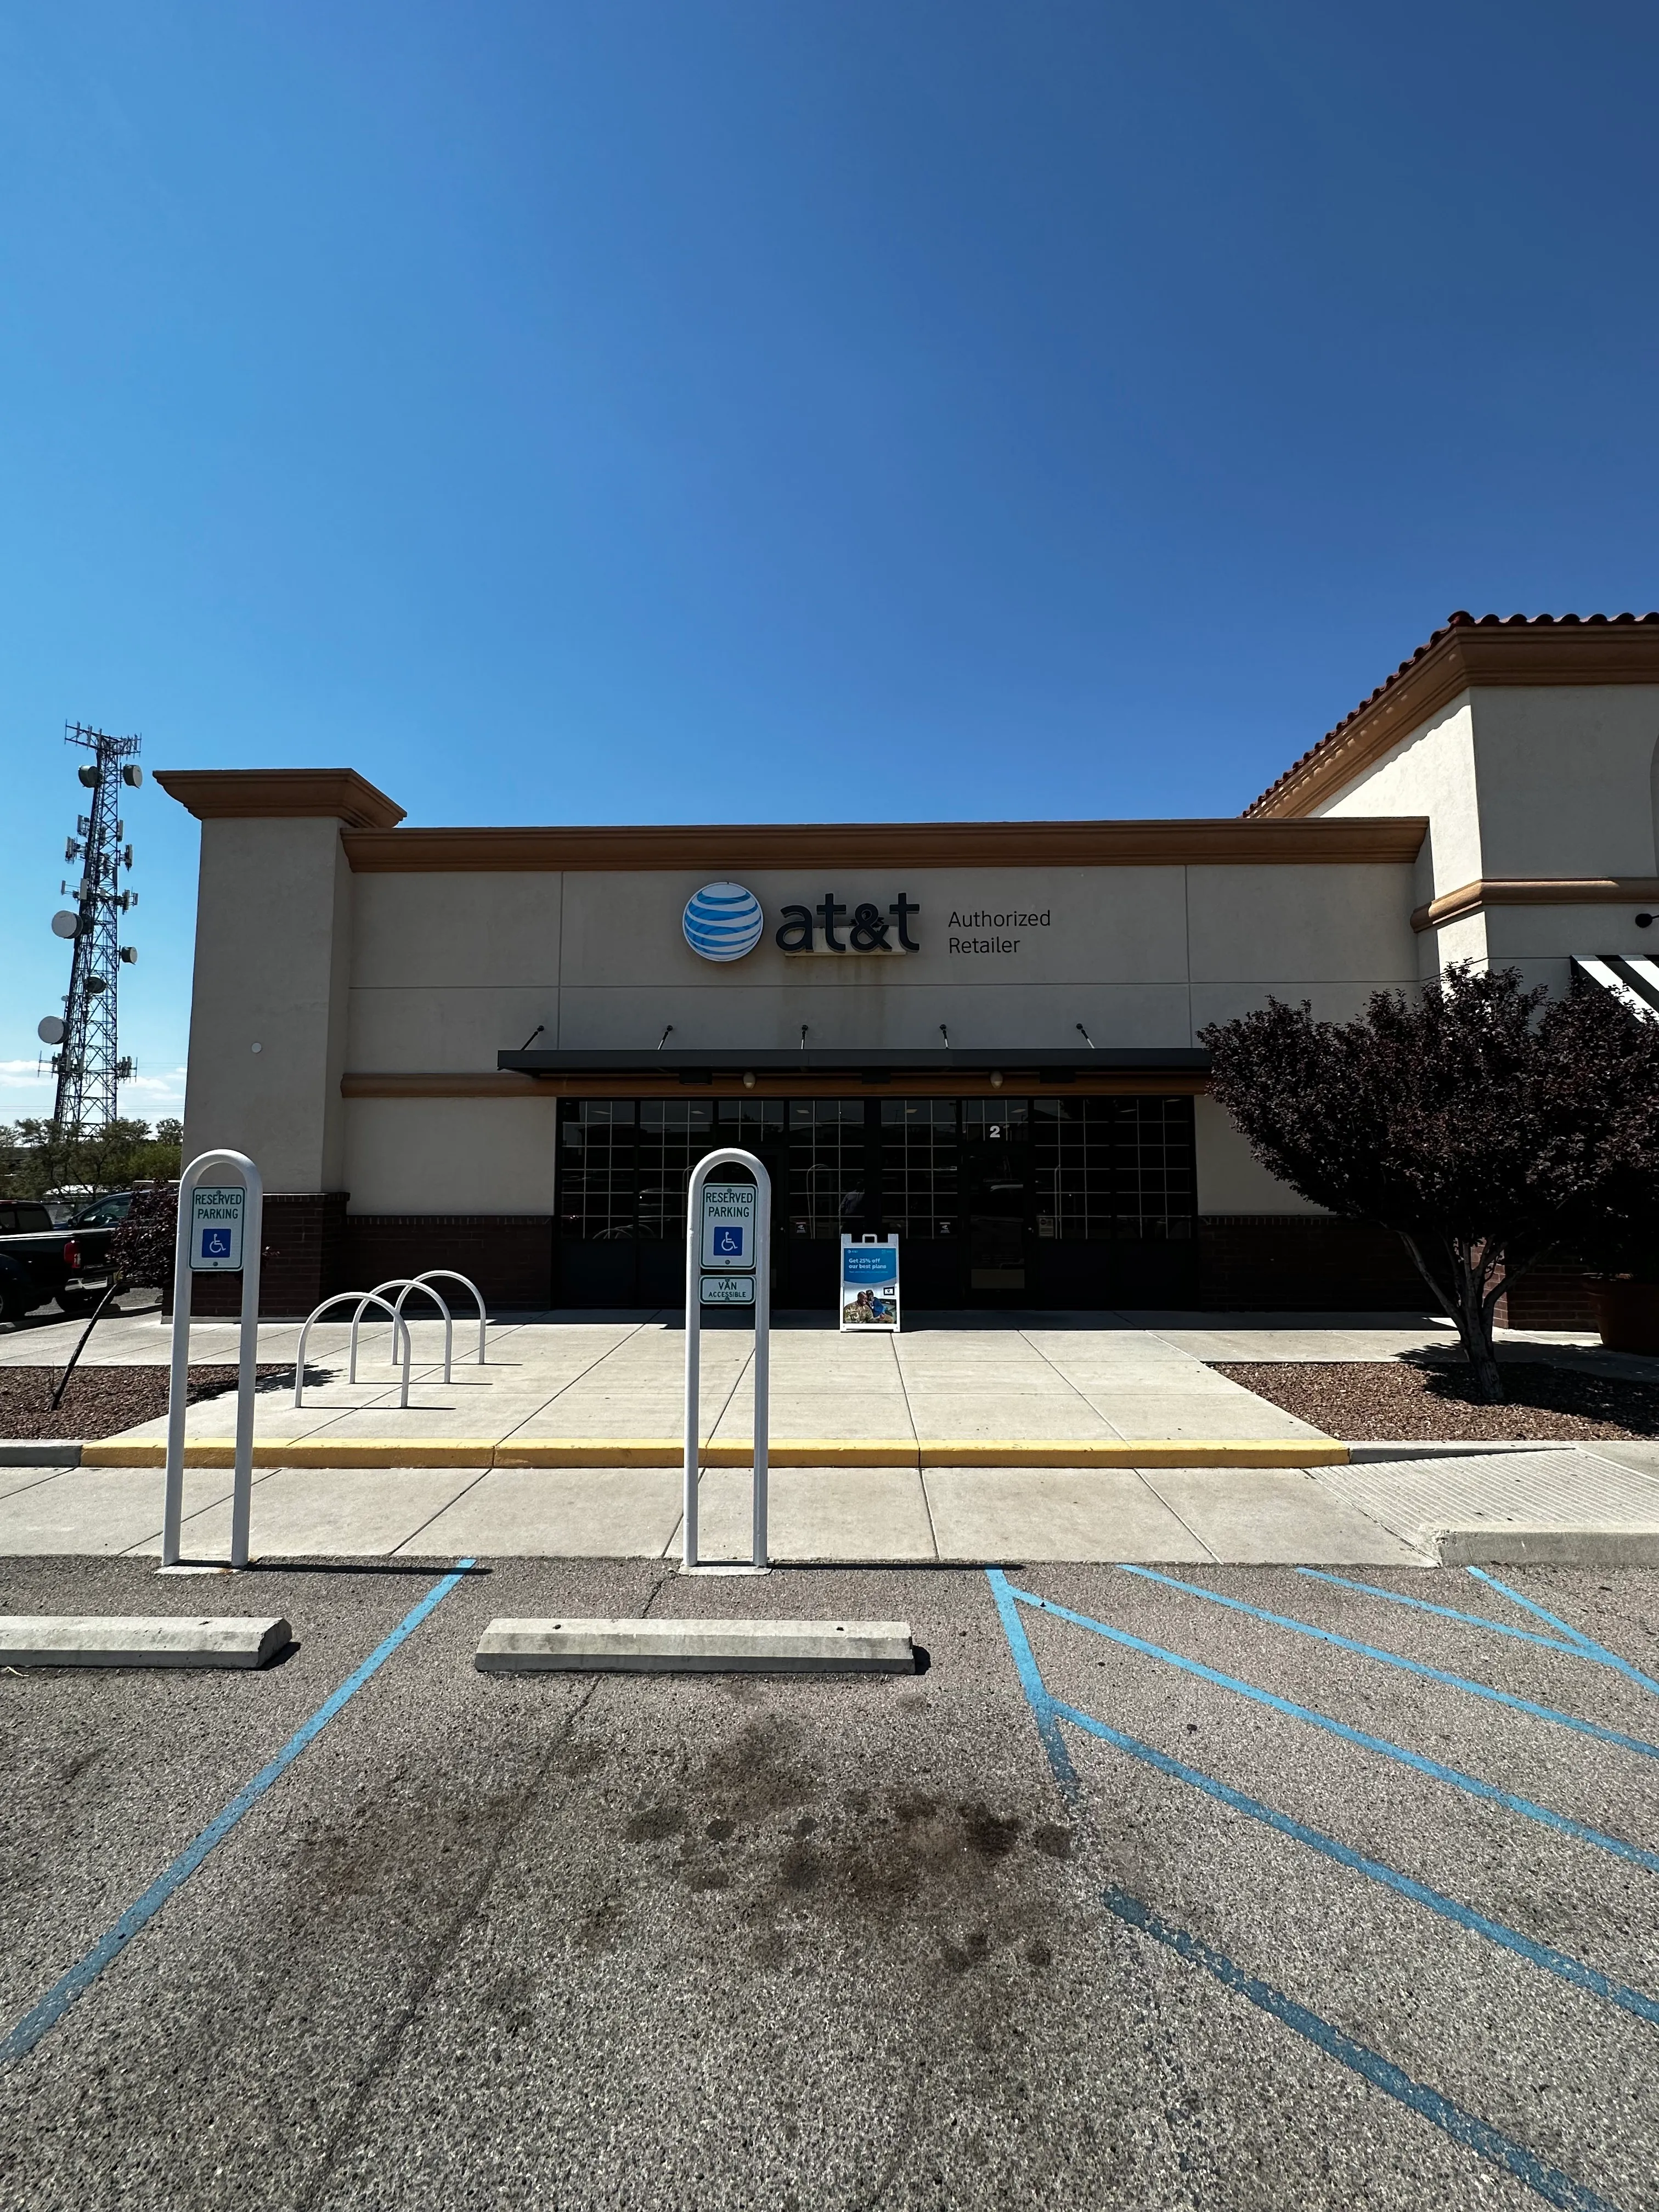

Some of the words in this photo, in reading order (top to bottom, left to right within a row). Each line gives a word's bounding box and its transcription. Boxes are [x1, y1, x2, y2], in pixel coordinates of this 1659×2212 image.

[776, 892, 920, 953] at&t
[948, 909, 1051, 928] Authorized
[949, 936, 1020, 954] Retailer
[989, 1125, 1001, 1138] 2
[195, 1194, 242, 1205] RESERVED
[706, 1192, 753, 1203] RESERVED
[198, 1209, 238, 1219] PARKING
[708, 1206, 749, 1217] PARKING
[718, 1282, 737, 1290] VAN
